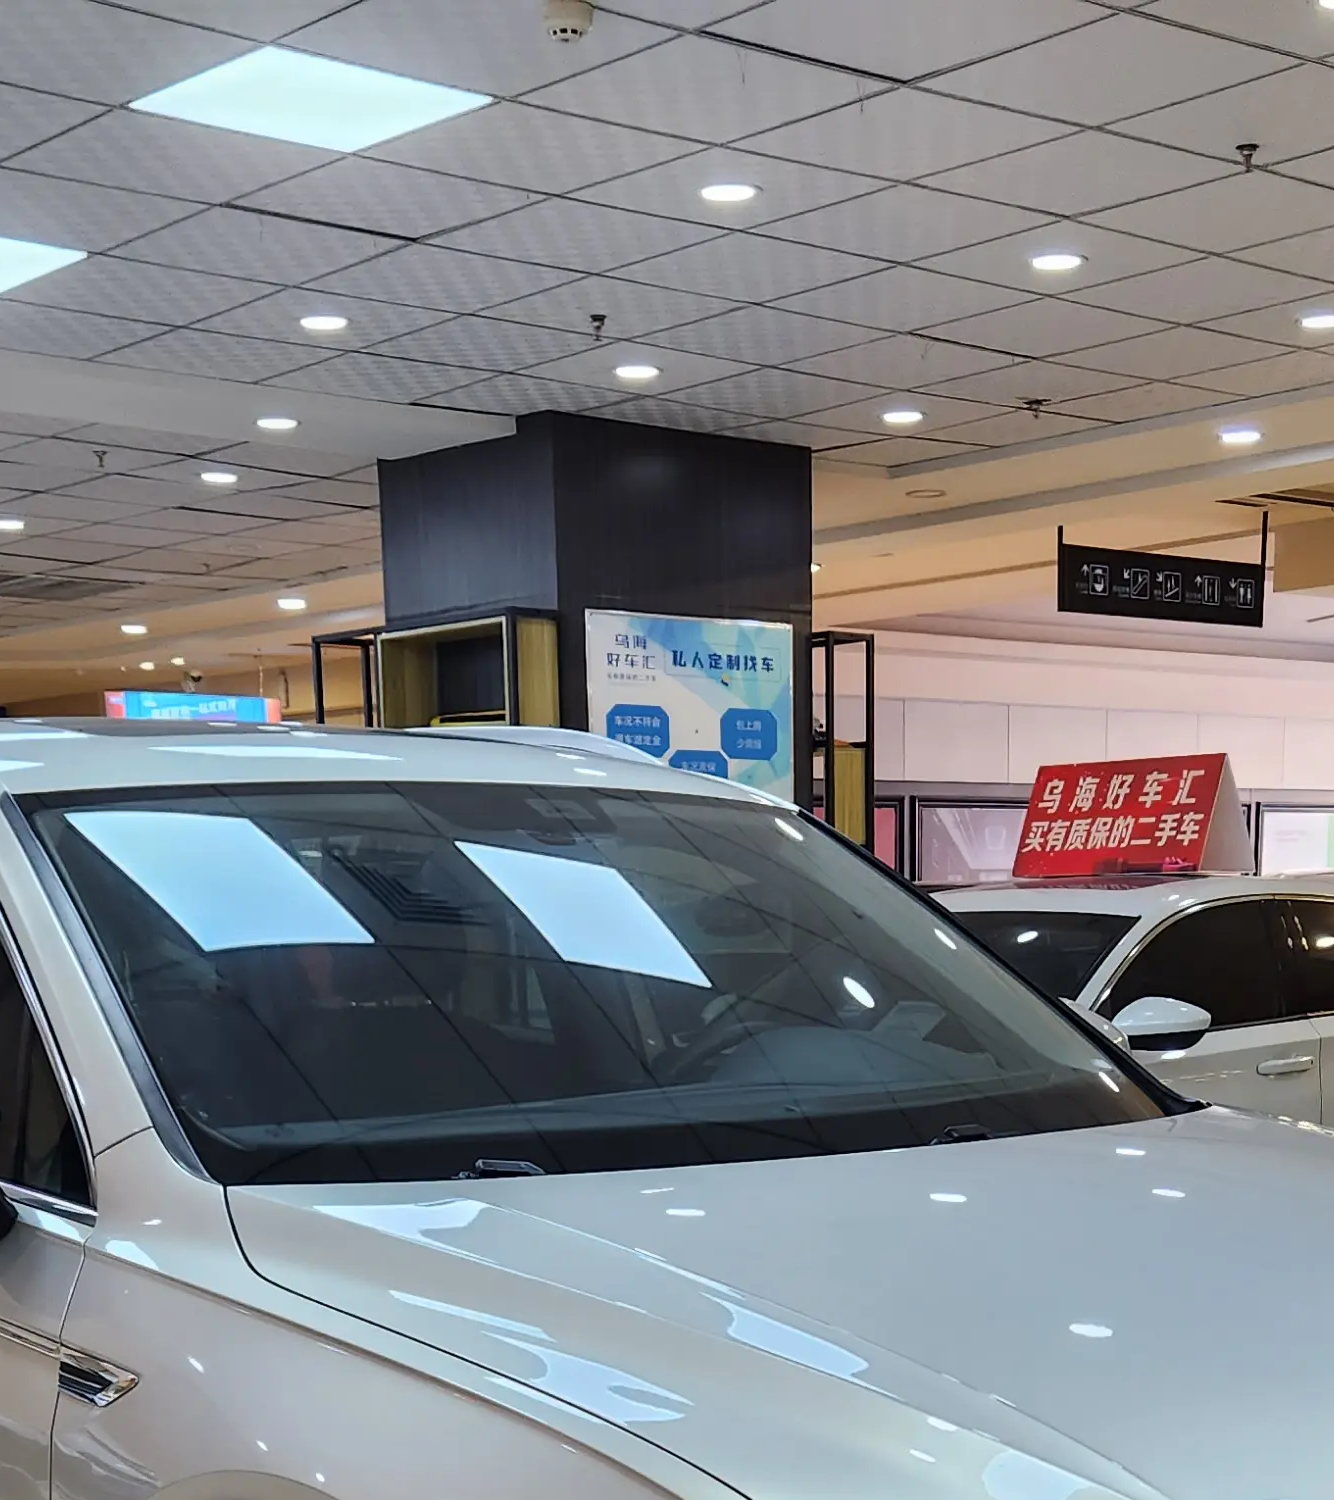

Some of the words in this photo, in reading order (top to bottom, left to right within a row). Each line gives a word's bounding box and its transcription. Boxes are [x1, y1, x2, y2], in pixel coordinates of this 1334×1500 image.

[614, 633, 647, 650] 乌海
[607, 652, 656, 670] 好车汇
[671, 650, 775, 673] 私人定制找车
[1038, 769, 1205, 814] 乌海好车汇
[1021, 811, 1204, 853] 买有质保的二手车
